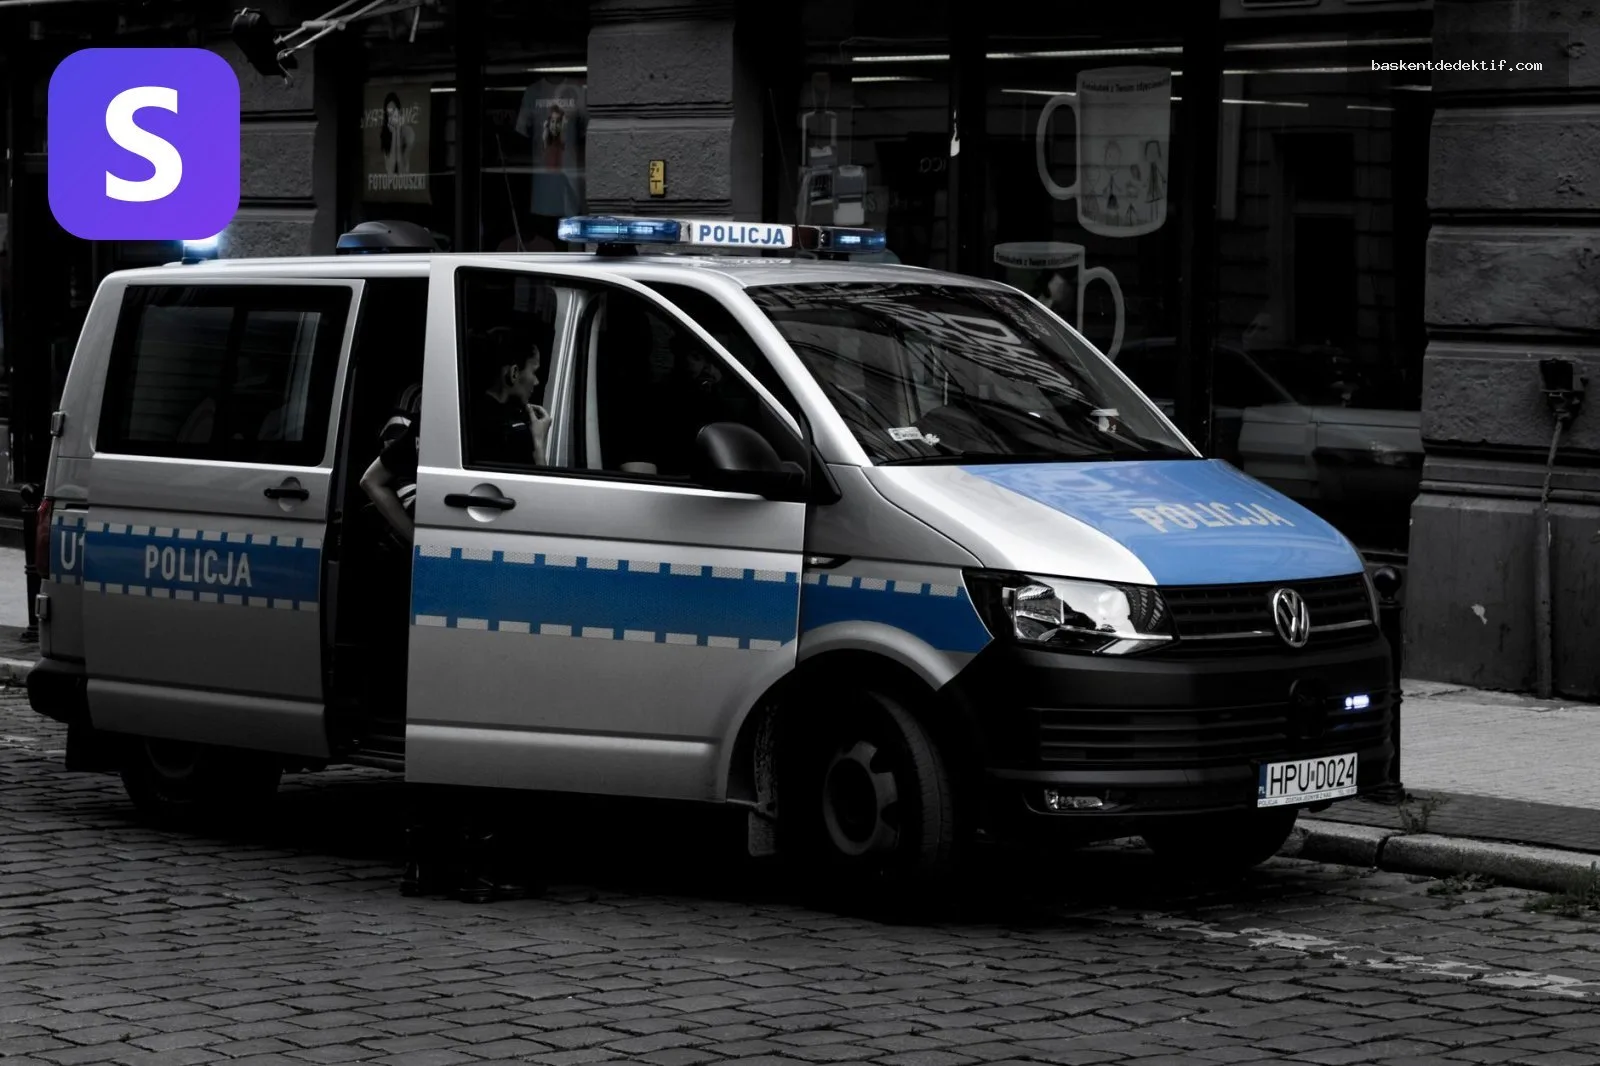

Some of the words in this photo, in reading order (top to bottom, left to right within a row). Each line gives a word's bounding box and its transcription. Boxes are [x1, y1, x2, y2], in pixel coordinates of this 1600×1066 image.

[368, 173, 426, 190] FOTOPODUSZKI
[698, 224, 785, 245] POLICJA
[1129, 502, 1296, 533] POLICJA
[144, 544, 252, 588] POLICJA
